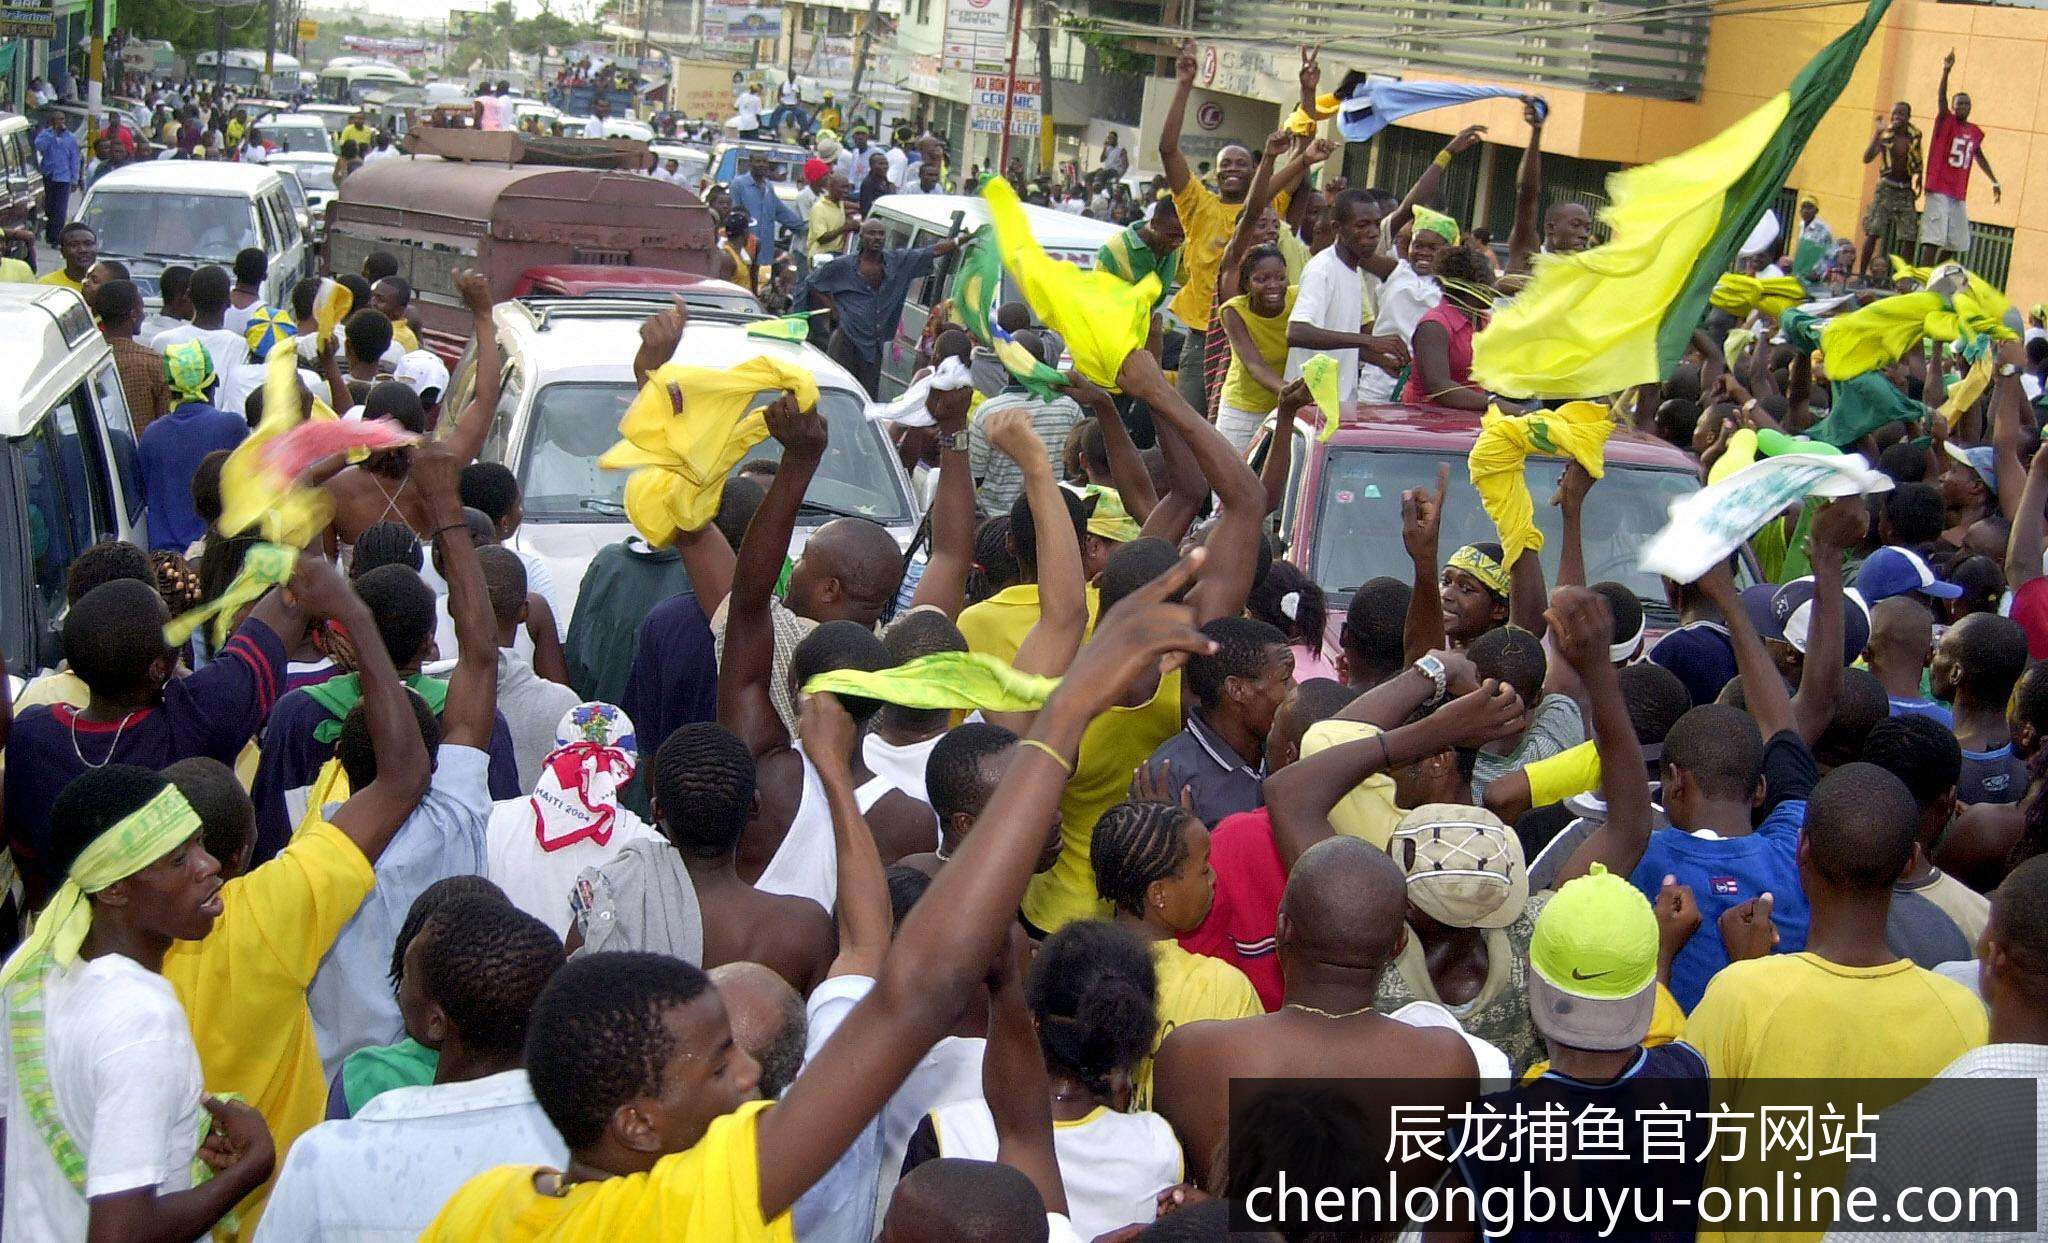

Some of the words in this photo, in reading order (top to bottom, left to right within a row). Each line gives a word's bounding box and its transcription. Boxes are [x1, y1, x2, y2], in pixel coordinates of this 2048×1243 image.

[982, 93, 1033, 109] CERMIC
[535, 788, 564, 810] HAITI
[565, 806, 590, 822] 2004
